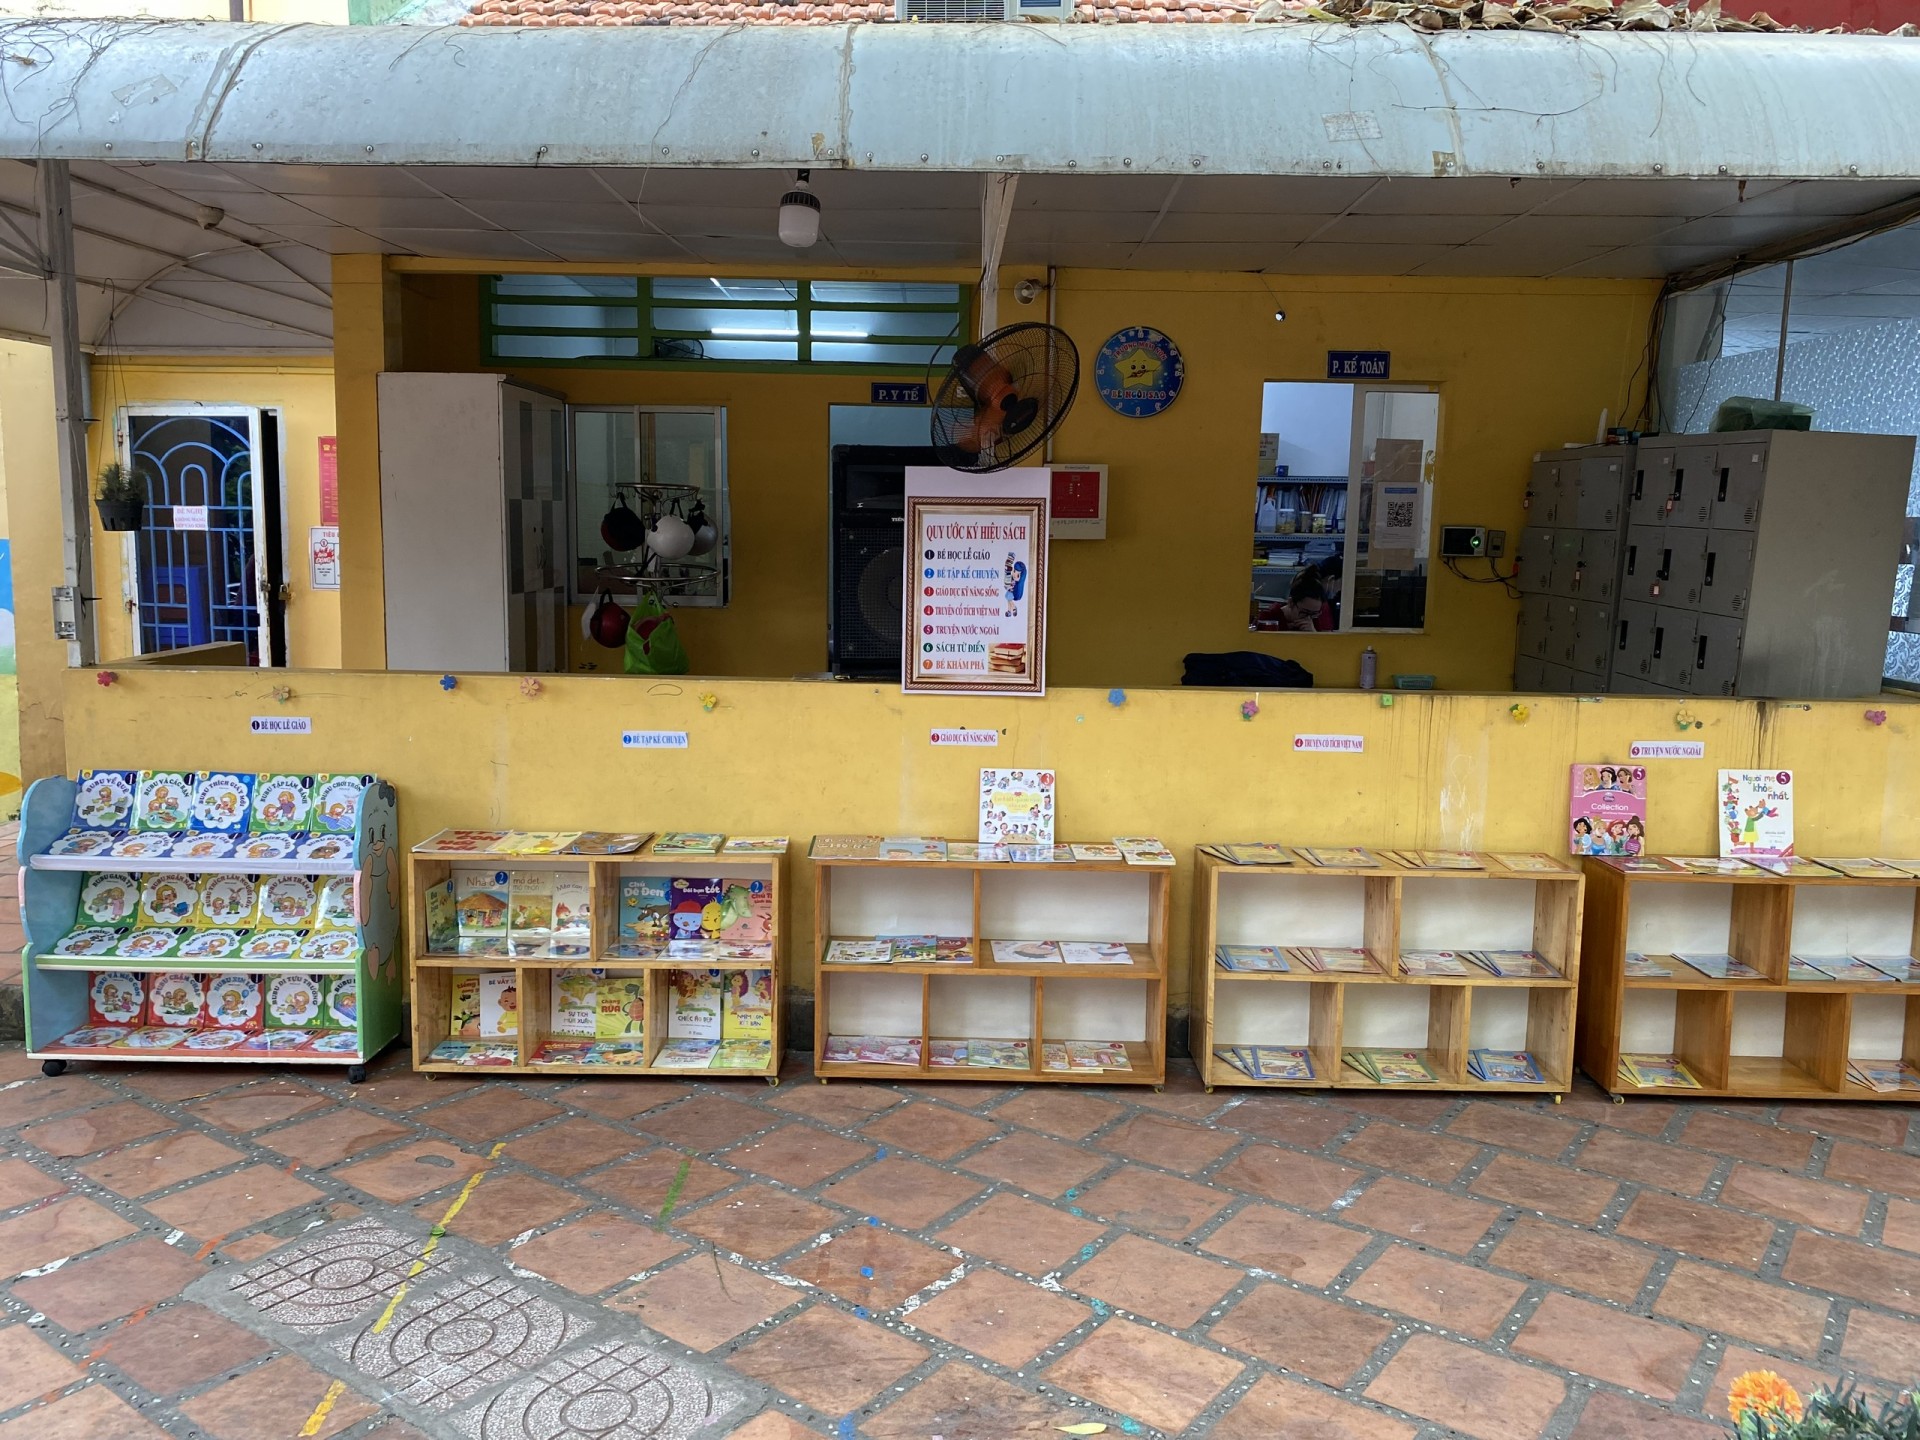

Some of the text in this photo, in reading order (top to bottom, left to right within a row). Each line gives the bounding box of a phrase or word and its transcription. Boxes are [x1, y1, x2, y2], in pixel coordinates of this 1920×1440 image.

[1332, 355, 1385, 374] P. KẾ TOÁN
[878, 386, 920, 400] P. Y TẾ
[1148, 390, 1166, 400] SAO
[926, 522, 1026, 543] QUY ƯỚC KÝ HIỆU SÁCH
[937, 547, 990, 561] BÉ HỌC LỄ GIÁO
[937, 567, 945, 578] BÉ
[948, 567, 960, 580] TẬP
[972, 567, 999, 581] CHUYỆN
[936, 586, 949, 596] GIÁO
[950, 588, 960, 598] DỤC
[935, 604, 954, 618] TRUYỆN
[964, 605, 975, 616] TÍCH
[976, 605, 988, 618] VIỆT
[988, 608, 1000, 616] NAM
[936, 624, 960, 636] TRUYỆN
[961, 624, 977, 635] NƯỚC
[980, 625, 999, 635] NGOÀI
[936, 642, 954, 652] SÁCH
[957, 642, 966, 652] TỪ
[968, 640, 985, 653] ĐIỂN
[936, 659, 985, 670] BÉ KHÁM PHÁ
[261, 719, 268, 730] BÉ
[270, 721, 281, 732] HỌC
[291, 719, 306, 730] GIÁO
[633, 734, 640, 744] BÉ
[1352, 740, 1362, 748] NAM
[1641, 745, 1702, 757] TRUYỆN NƯỚC NGOÀI
[1768, 791, 1789, 800] nhất
[1591, 803, 1628, 811] Collection
[466, 876, 486, 886] Nhà
[624, 888, 664, 897] Dê Đen
[705, 883, 721, 894] tốt
